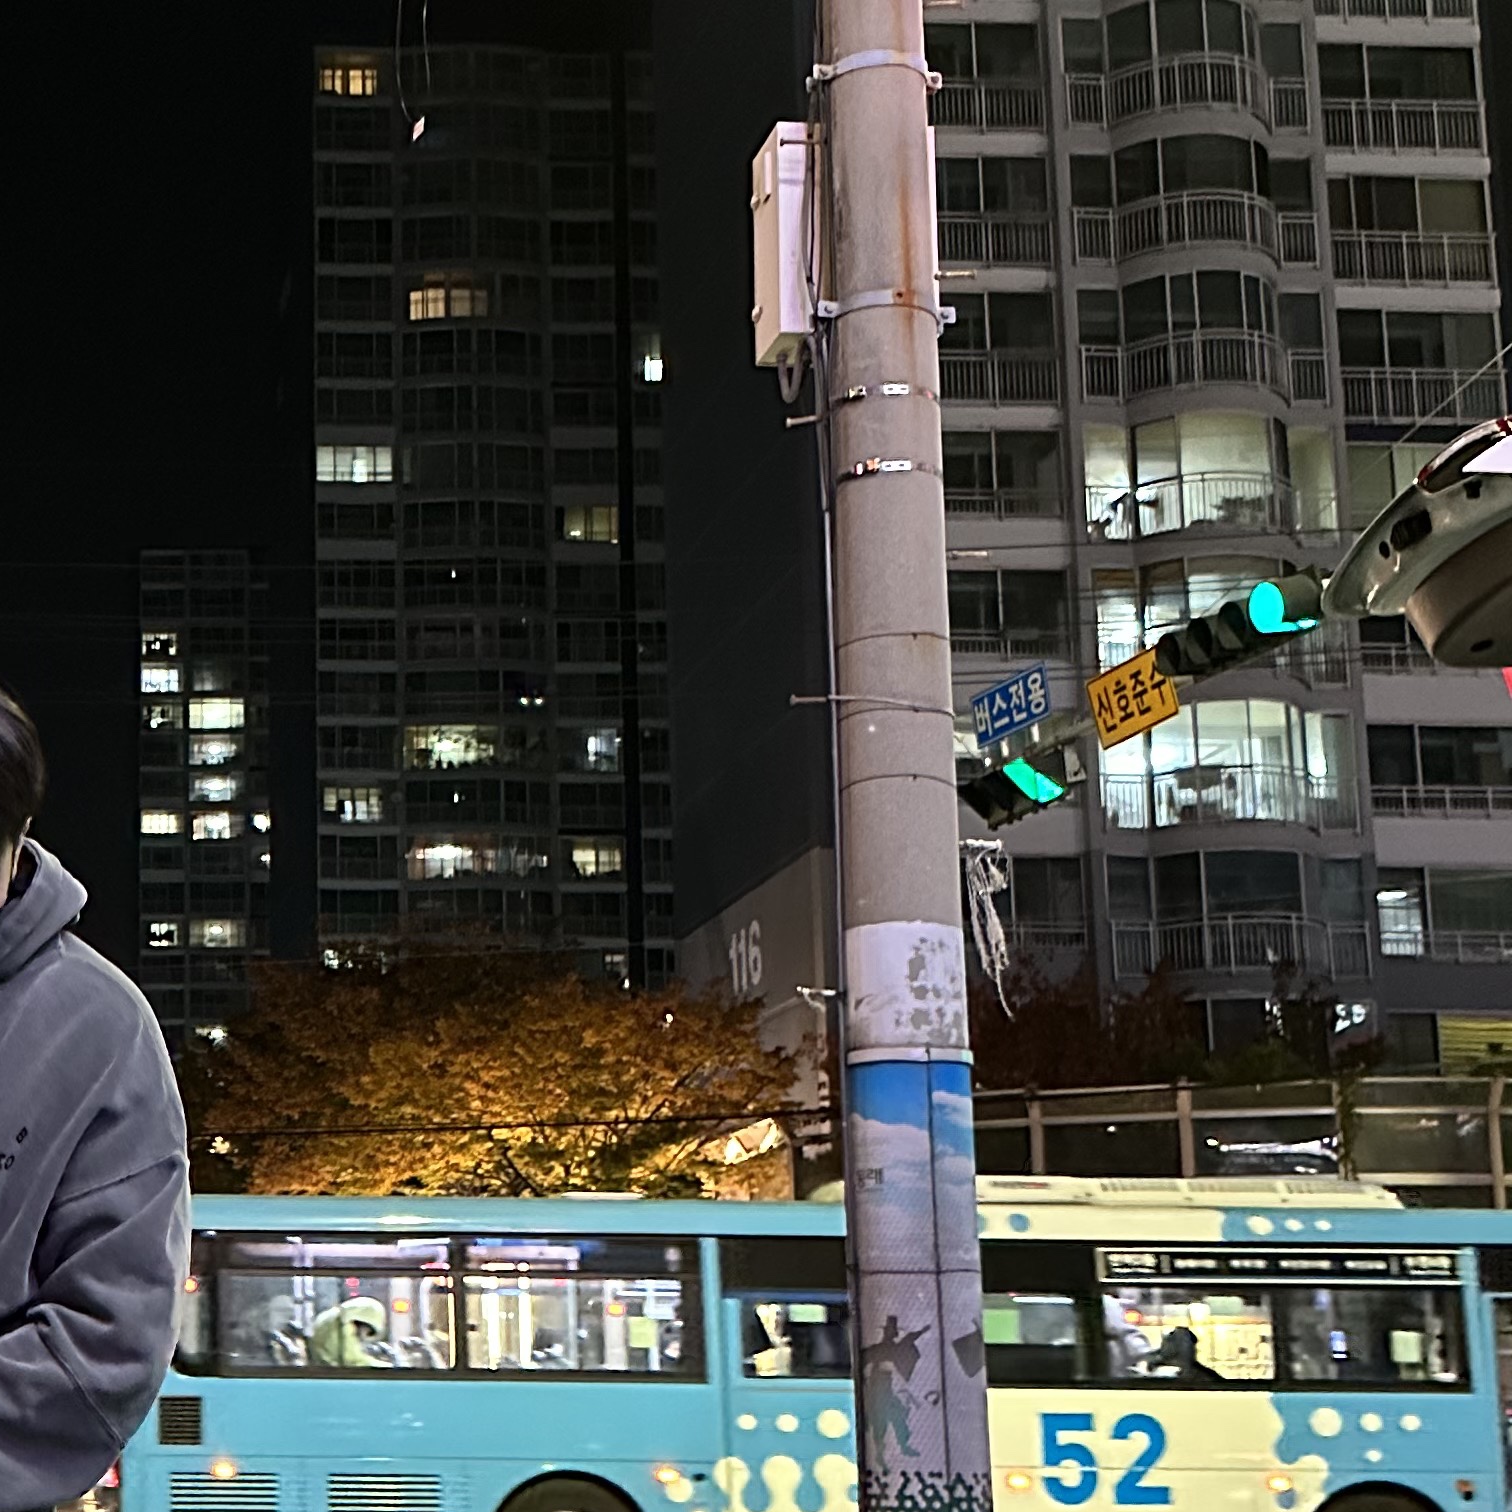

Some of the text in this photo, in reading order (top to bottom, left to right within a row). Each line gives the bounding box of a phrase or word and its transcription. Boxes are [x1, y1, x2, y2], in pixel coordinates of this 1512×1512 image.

[974, 671, 1045, 737] 버스전용
[1096, 661, 1167, 733] 신호준수
[729, 920, 762, 995] 116
[1041, 1413, 1172, 1505] 52
